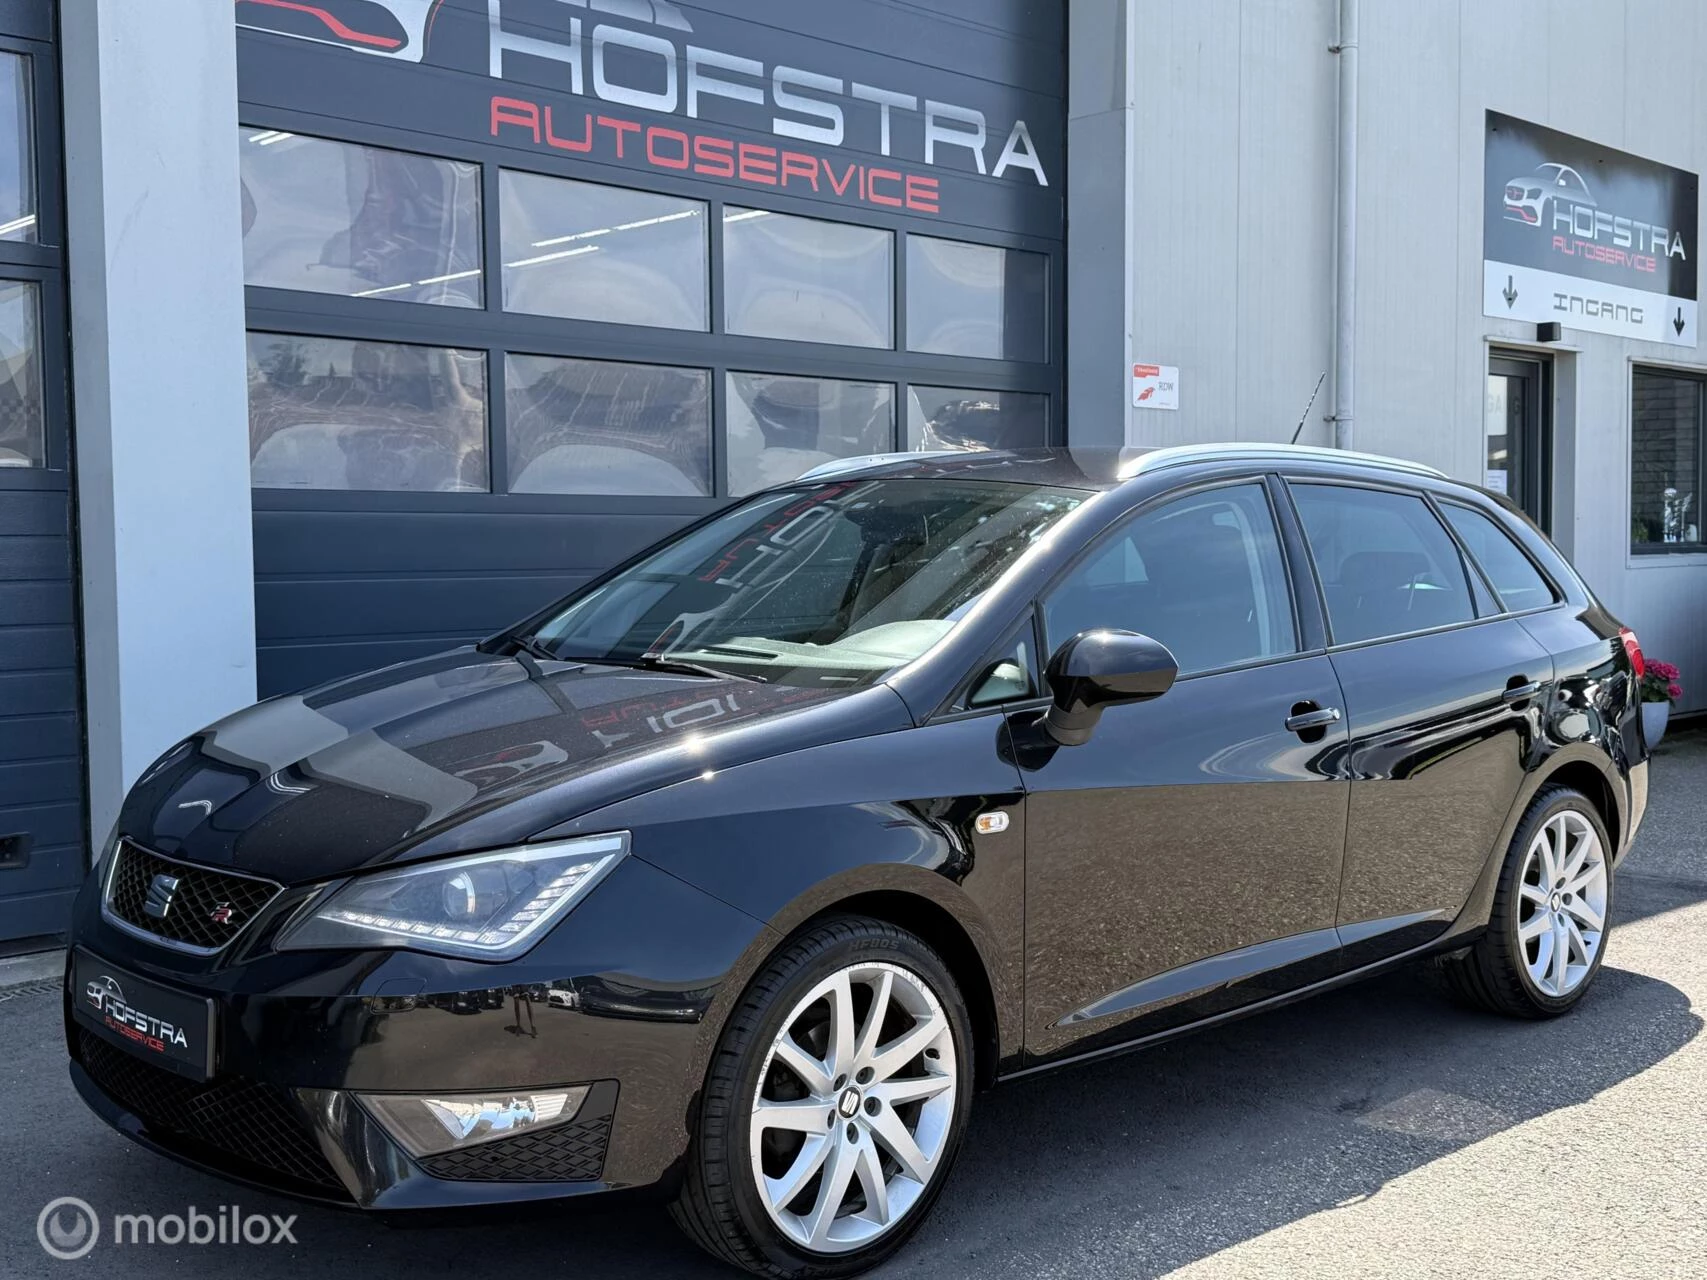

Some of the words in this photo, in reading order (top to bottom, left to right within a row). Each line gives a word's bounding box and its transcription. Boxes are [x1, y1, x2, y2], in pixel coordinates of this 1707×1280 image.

[488, 0, 1049, 187] HOFSTRA
[489, 95, 940, 213] AUTOSERVICE
[1553, 200, 1686, 260] HOFSTRA
[1553, 236, 1656, 272] AUTOSERVICE
[1553, 292, 1644, 324] INGANG
[105, 995, 188, 1048] HOFSTRA
[105, 1015, 165, 1052] AUTOSERVICE
